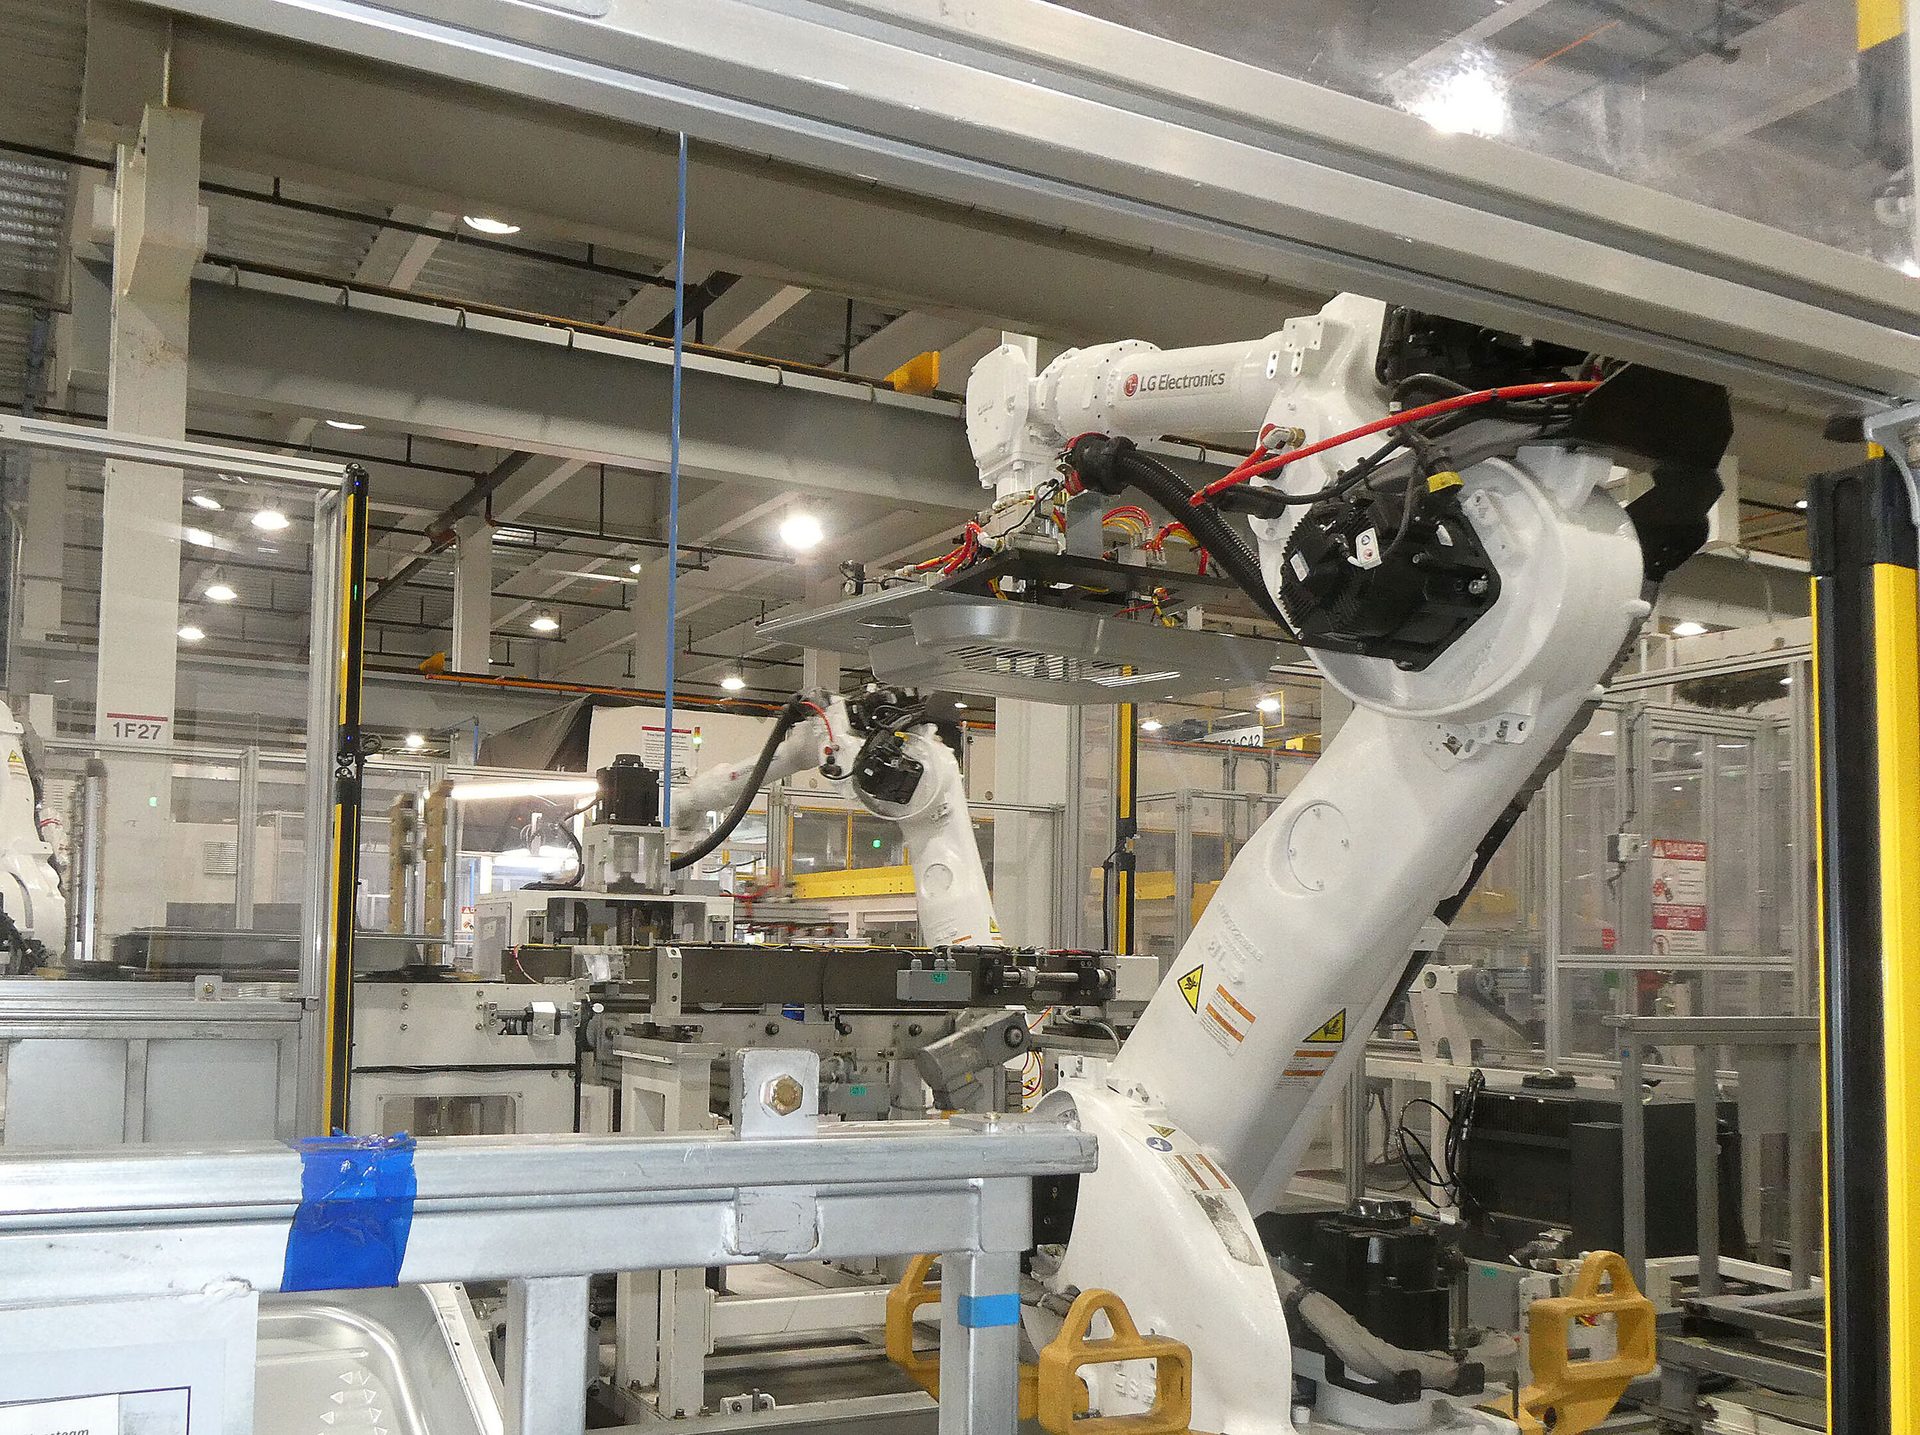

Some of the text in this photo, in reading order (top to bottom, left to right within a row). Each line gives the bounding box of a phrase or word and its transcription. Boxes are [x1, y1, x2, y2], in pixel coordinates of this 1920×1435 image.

[1139, 370, 1225, 392] LG Electronics
[112, 722, 162, 740] 1F27
